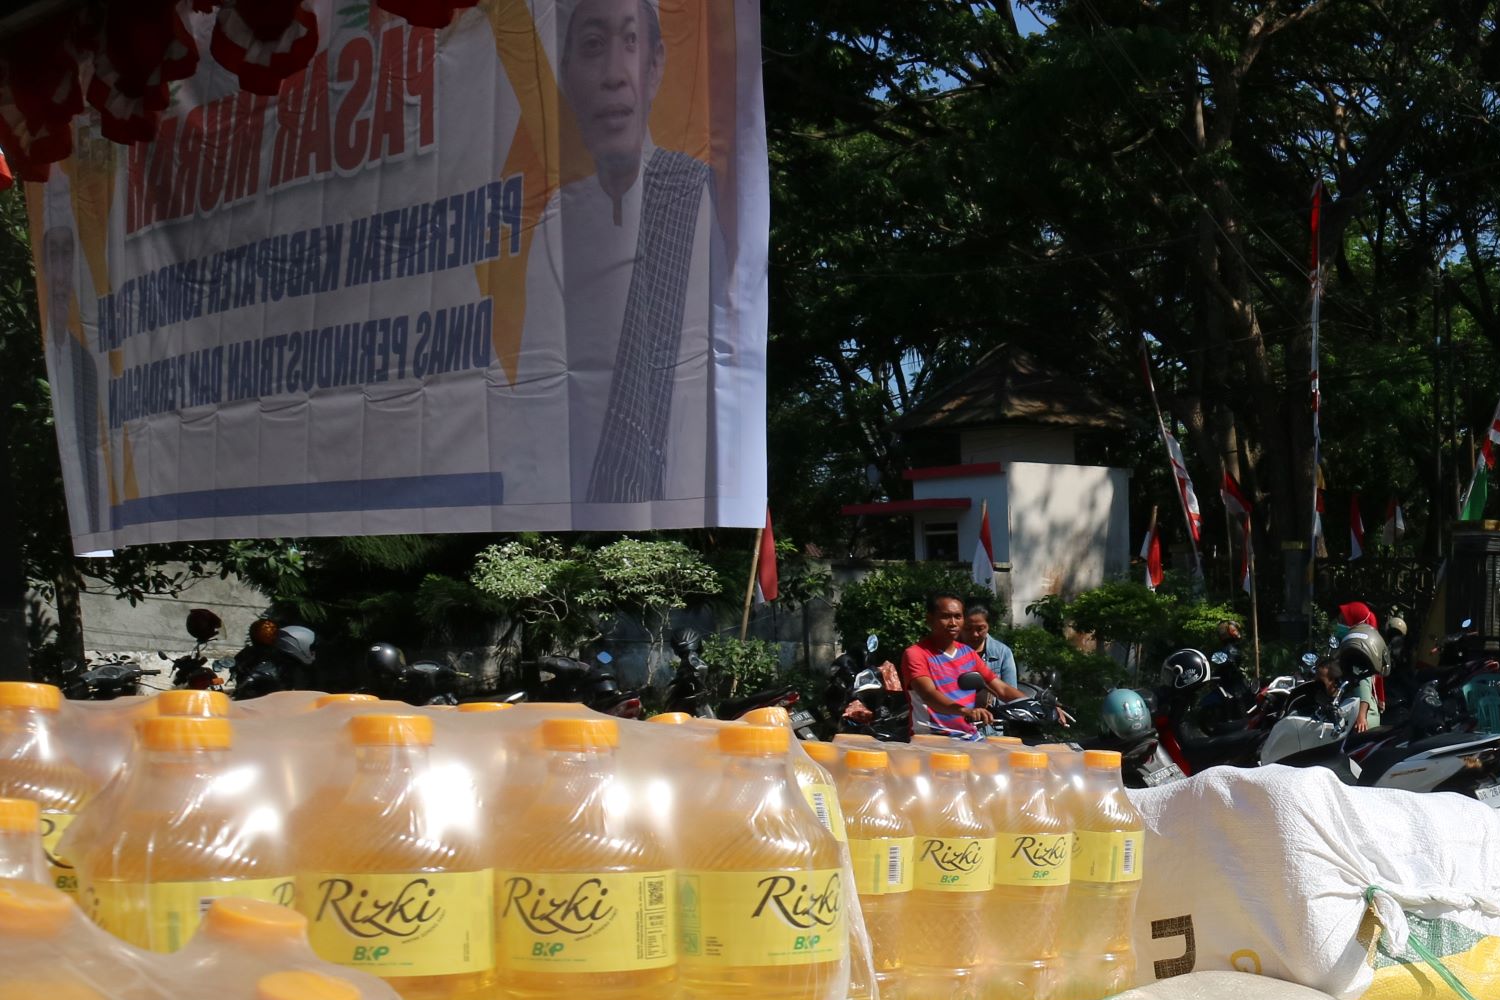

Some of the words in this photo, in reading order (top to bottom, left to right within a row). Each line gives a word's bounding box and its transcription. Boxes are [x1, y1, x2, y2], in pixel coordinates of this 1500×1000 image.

[919, 839, 984, 872] Rizki
[1010, 836, 1067, 867] Rizki
[315, 878, 441, 938] Rizki
[502, 877, 613, 935] Rizki
[752, 873, 841, 928] Rizki
